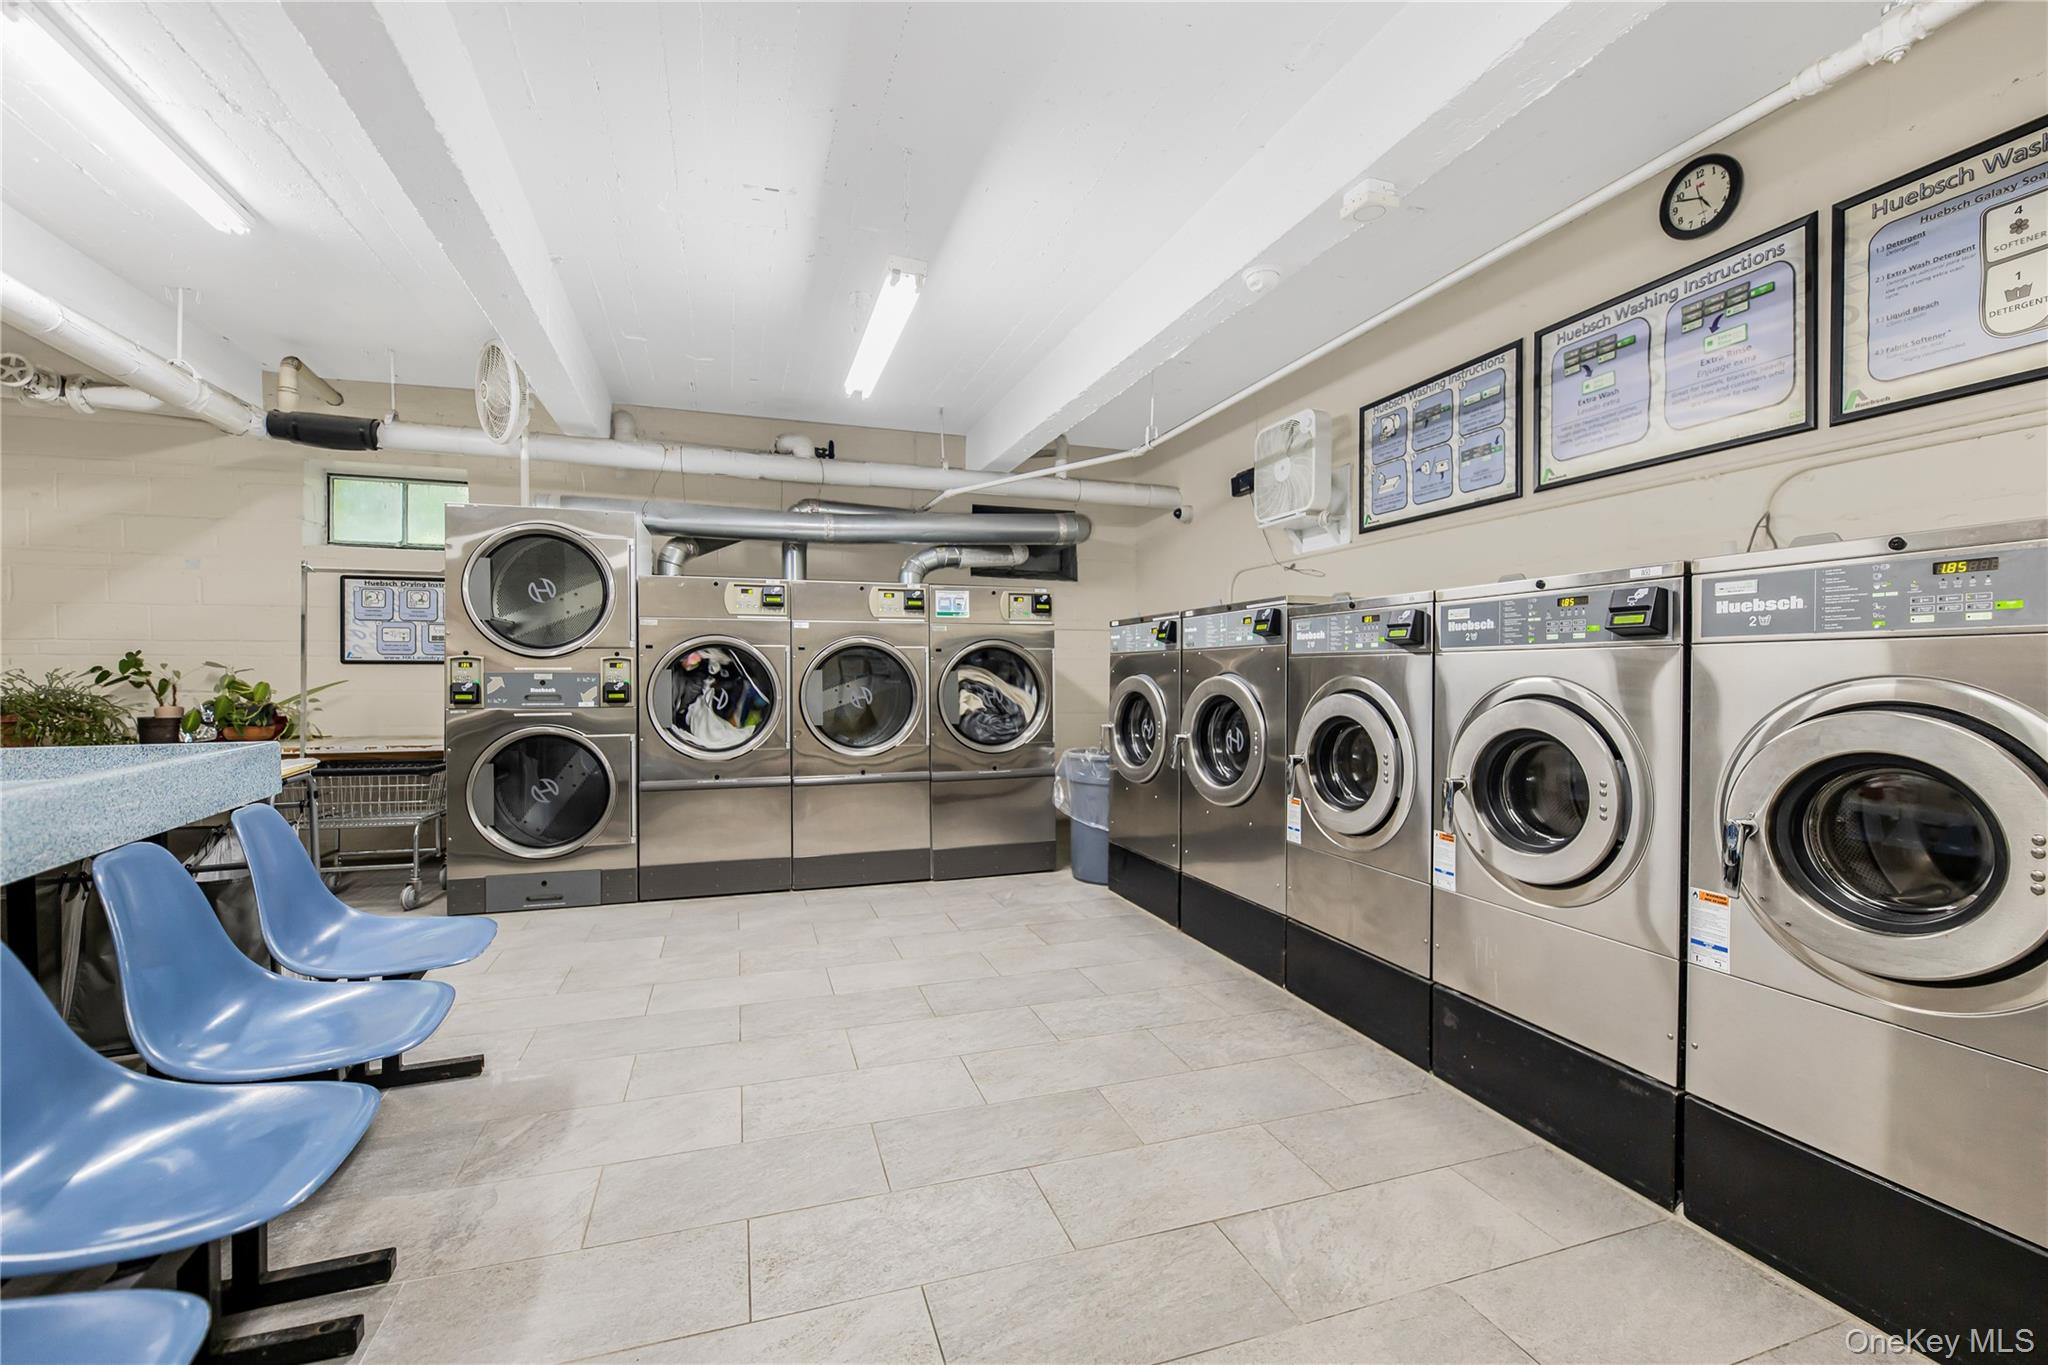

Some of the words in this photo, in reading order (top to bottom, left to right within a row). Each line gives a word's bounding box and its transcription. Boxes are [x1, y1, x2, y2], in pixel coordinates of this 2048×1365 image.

[1696, 168, 1705, 180] 12
[1872, 167, 1975, 219] Huebsch
[1920, 199, 1971, 225] Huebsch
[1974, 182, 2018, 206] Galaxy
[2022, 168, 2048, 186] Soa
[1672, 207, 1679, 216] 9
[2014, 205, 2024, 215] 4
[1689, 220, 1694, 230] 7
[1886, 231, 1927, 251] Detergent
[1993, 230, 2048, 254] SOFTENER
[1886, 267, 1907, 280] Extra
[1909, 258, 1931, 272] Wash
[1932, 244, 1977, 264] Detergent
[2015, 271, 2022, 281] 1
[1556, 316, 1611, 346] Huebsch
[1615, 286, 1680, 322] Washing
[1683, 243, 1786, 295] Instructions
[1886, 307, 1912, 321] Liquid
[1912, 299, 1940, 313] Bleach
[1989, 295, 2048, 319] DETERGENT
[1911, 331, 1947, 346] Softener
[1700, 355, 1724, 367] Extra
[1372, 395, 1407, 416] Huebsch
[1408, 378, 1446, 402] Washing
[1448, 354, 1506, 387] Instructions
[1578, 396, 1598, 407] Extra
[1599, 388, 1620, 400] Wash
[364, 580, 398, 588] Huebsch
[400, 581, 427, 589] Drying
[1716, 595, 1804, 615] Huebsch
[1448, 618, 1495, 632] Huebsch
